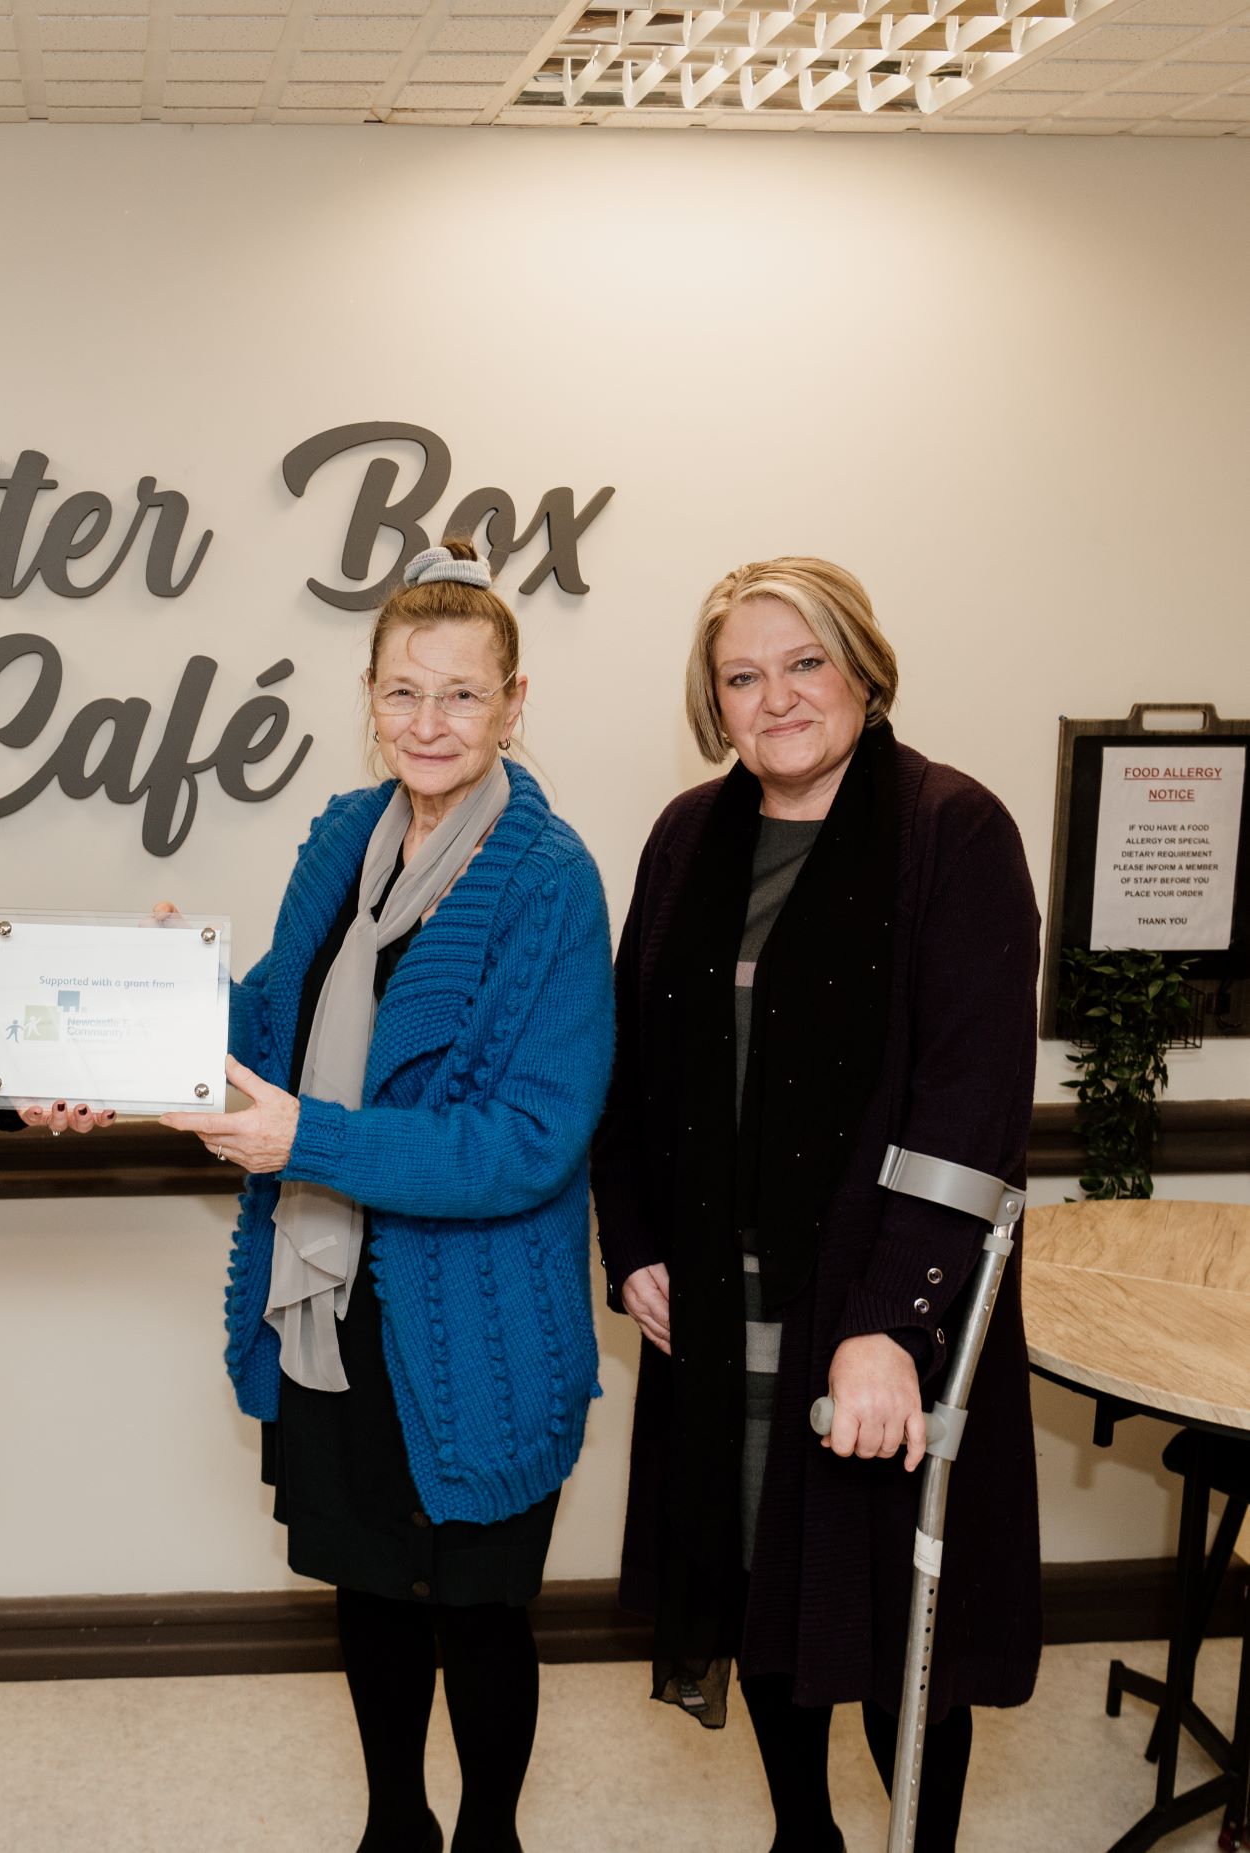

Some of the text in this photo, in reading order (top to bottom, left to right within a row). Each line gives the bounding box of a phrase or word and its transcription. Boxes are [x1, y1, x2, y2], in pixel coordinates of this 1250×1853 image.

[282, 421, 616, 611] Box
[1124, 767, 1223, 778] FOOD ALLERGY
[1148, 789, 1195, 800] NOTICE
[1125, 837, 1210, 845] ALLERGY OR SPECIAL
[1121, 850, 1212, 858] DIETARY REQUIREMENT
[1113, 863, 1219, 871] PLEASE INFORM A MEMBER
[1120, 876, 1210, 884] OF STAFF BEFORE YOU
[1137, 917, 1188, 925] THANK YOU
[39, 975, 89, 987] Supported
[91, 977, 112, 987] with
[123, 980, 149, 989] grant
[152, 979, 175, 988] from
